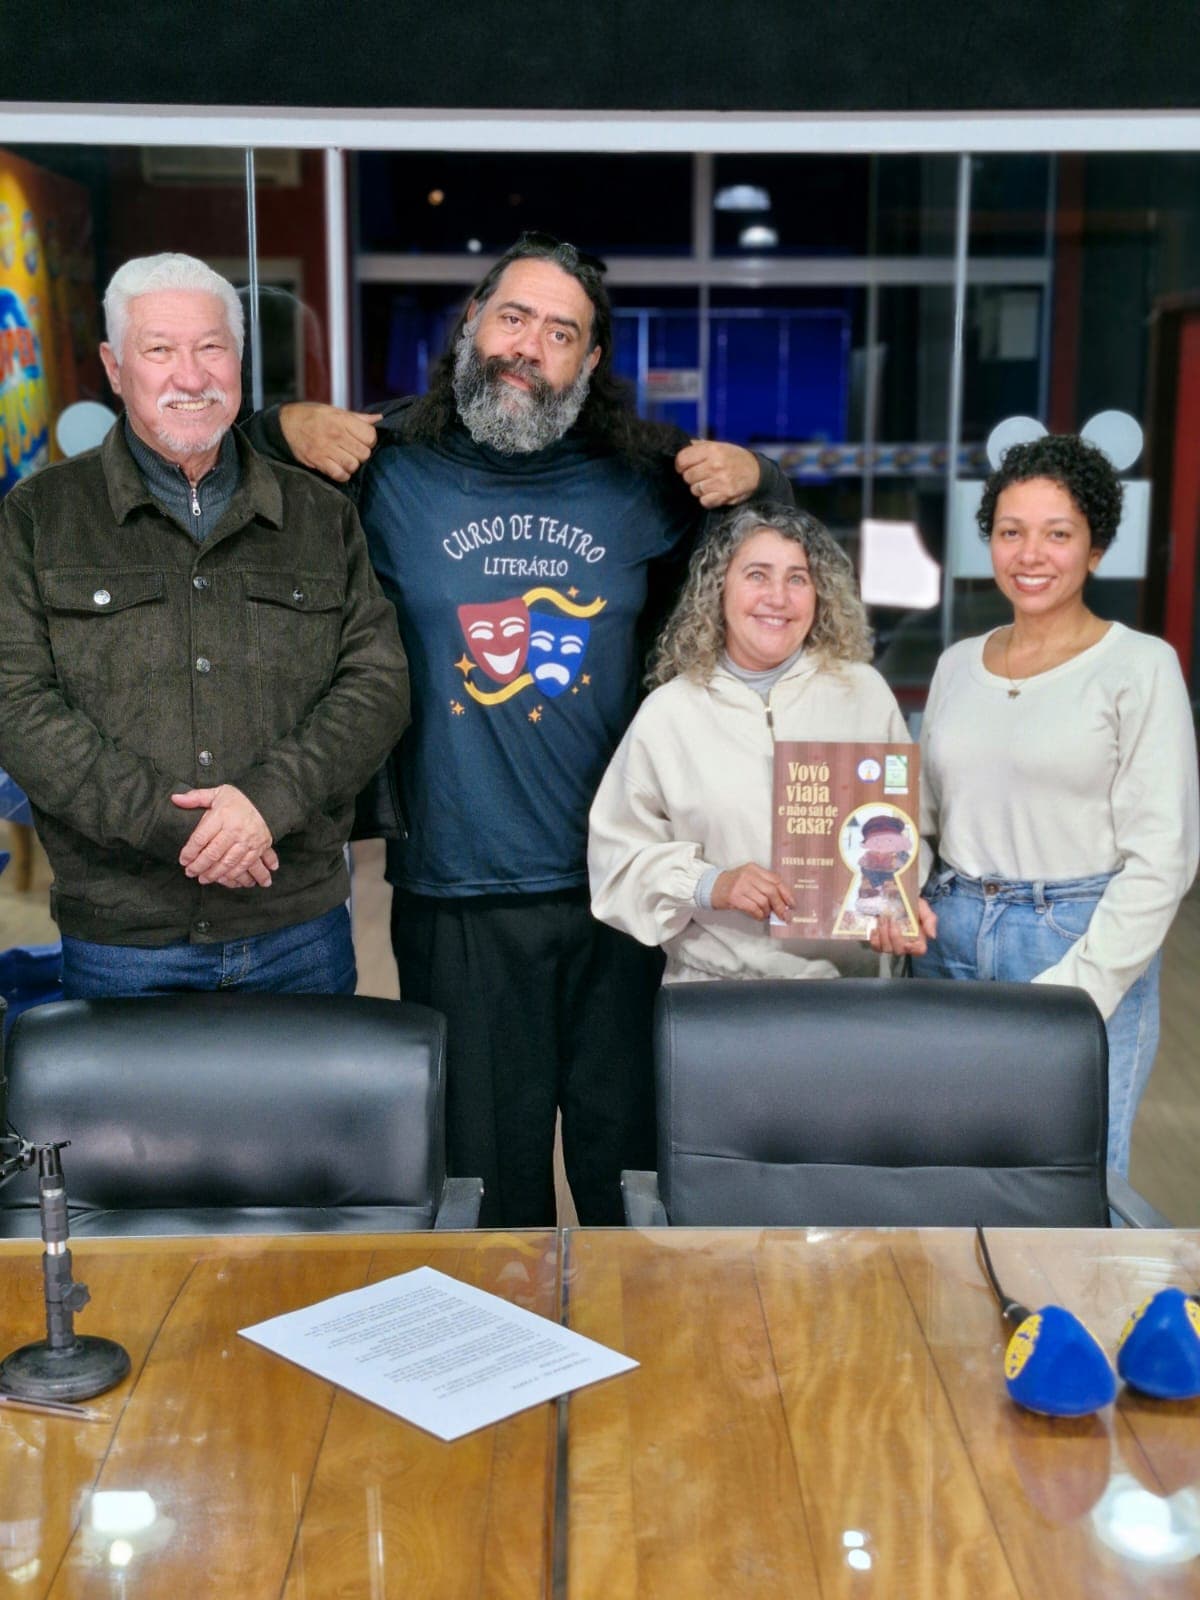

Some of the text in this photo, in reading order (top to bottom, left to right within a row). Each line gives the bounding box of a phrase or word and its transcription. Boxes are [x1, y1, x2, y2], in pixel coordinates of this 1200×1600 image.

[442, 514, 606, 563] CURSO DE TEATRO
[483, 556, 569, 577] LITERÁRIO
[787, 762, 830, 782] Vovó
[786, 782, 830, 804] viaja
[778, 804, 839, 817] e não sai de
[786, 817, 834, 835] casa?
